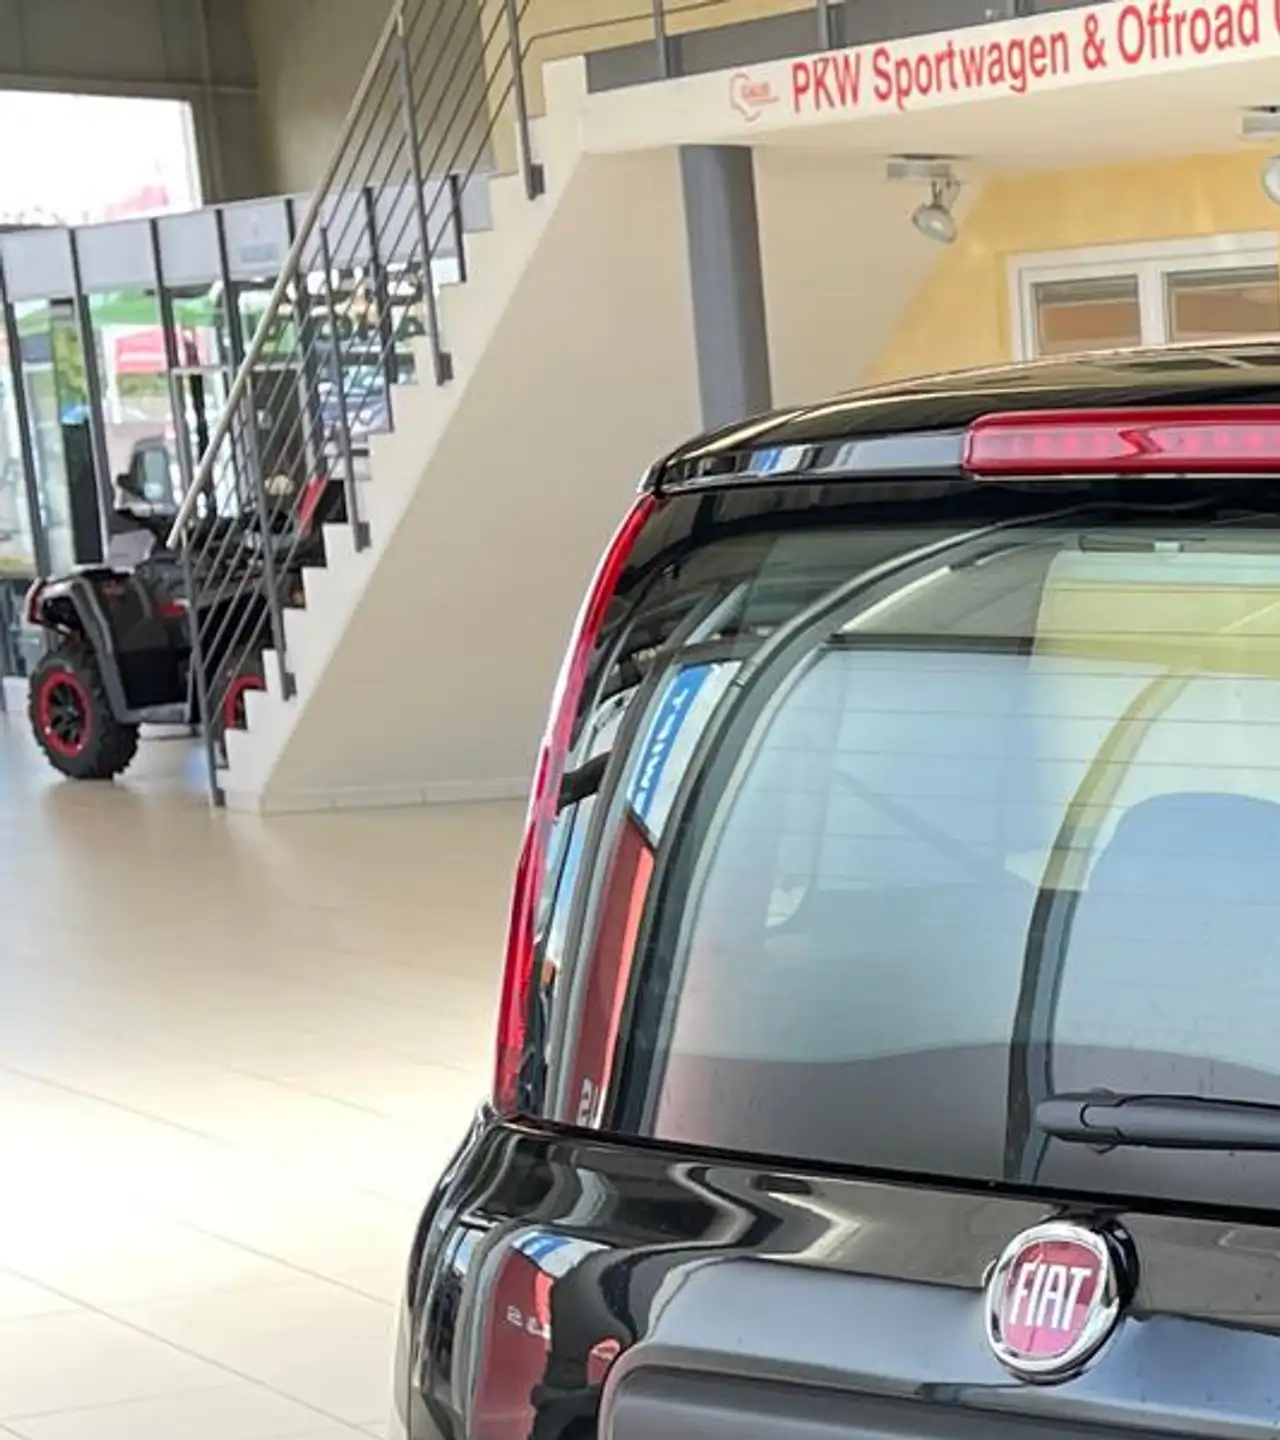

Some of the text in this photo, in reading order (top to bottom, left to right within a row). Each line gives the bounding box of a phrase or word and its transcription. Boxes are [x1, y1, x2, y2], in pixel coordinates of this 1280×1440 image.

[791, 53, 861, 113] PKW
[872, 31, 1070, 111] Sportwagen
[1082, 18, 1108, 70] &
[1117, 0, 1260, 63] Offroad
[1009, 1261, 1093, 1331] FIAT
